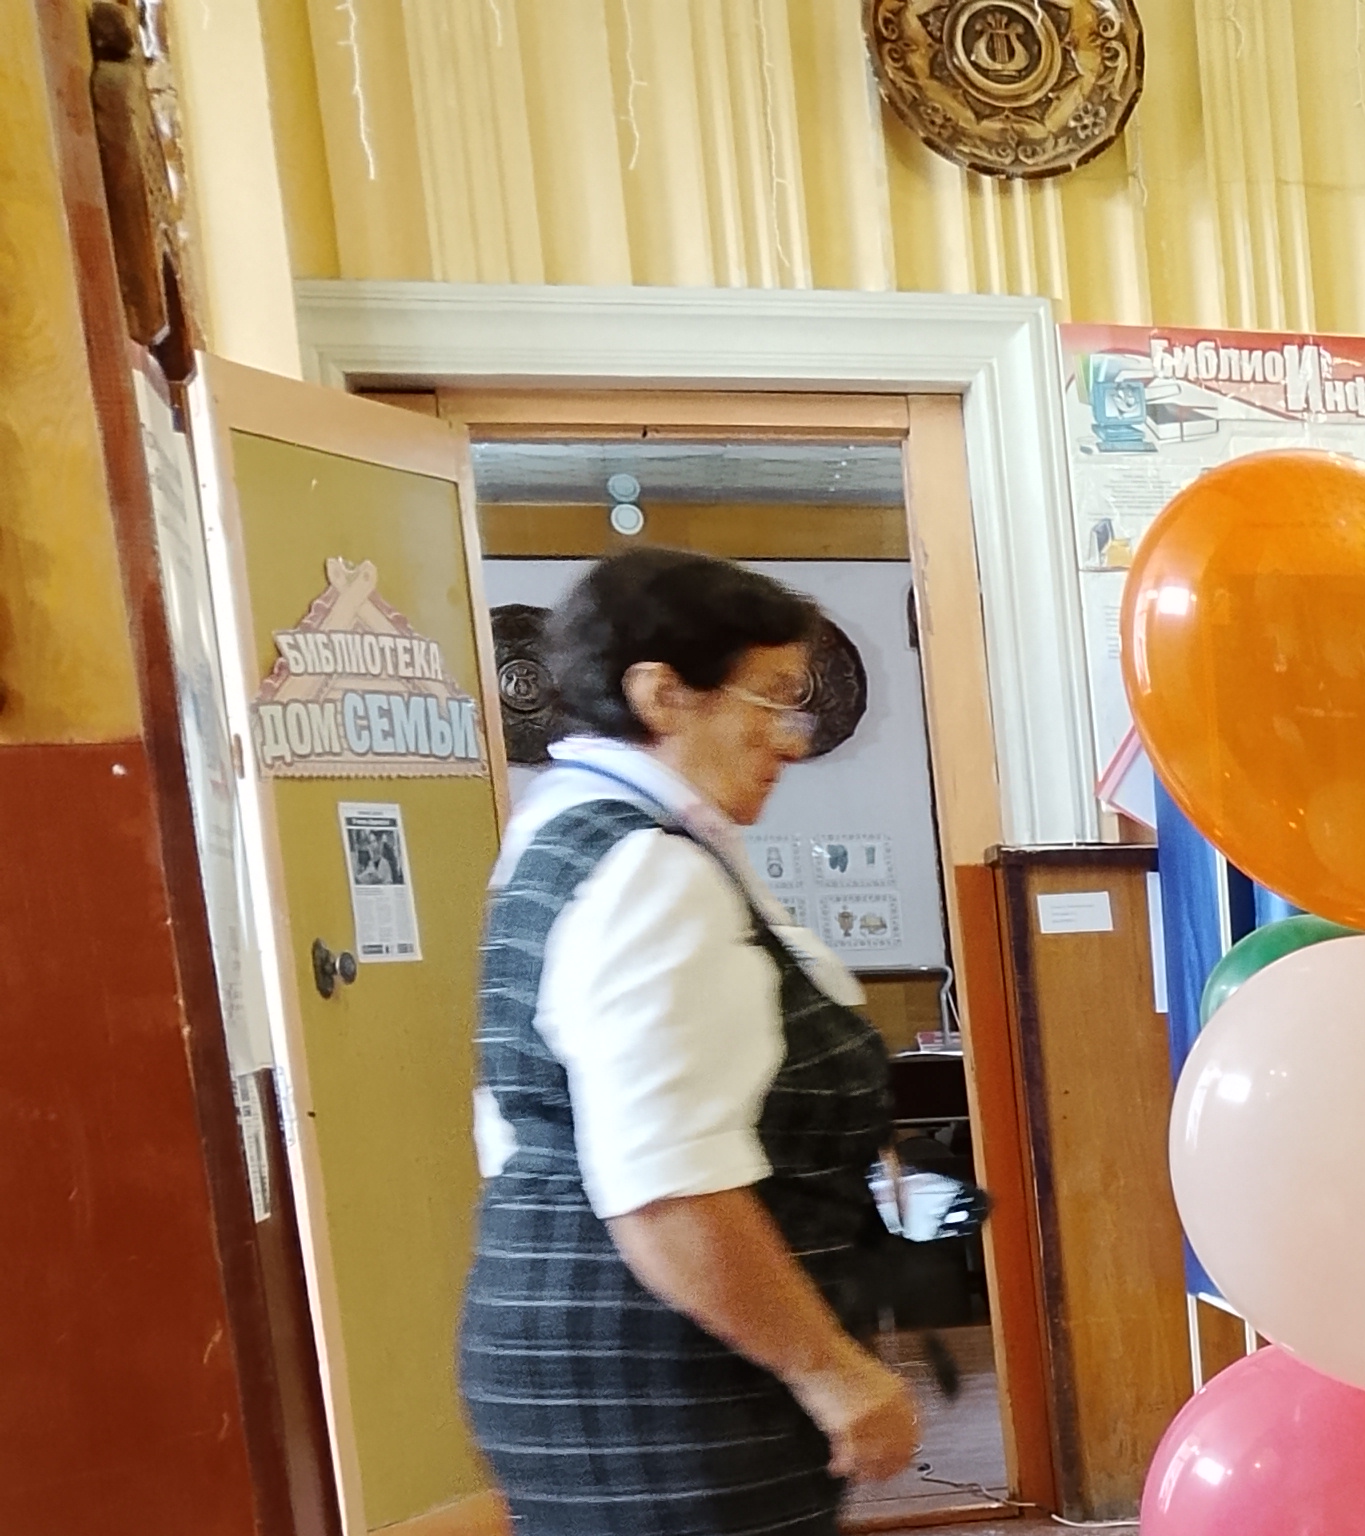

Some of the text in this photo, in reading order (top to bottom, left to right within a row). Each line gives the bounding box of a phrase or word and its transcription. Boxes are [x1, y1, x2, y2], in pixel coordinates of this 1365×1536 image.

[276, 632, 444, 681] БИБЛИОТЕКА
[259, 692, 479, 768] ДОМ СЕМЬИ
